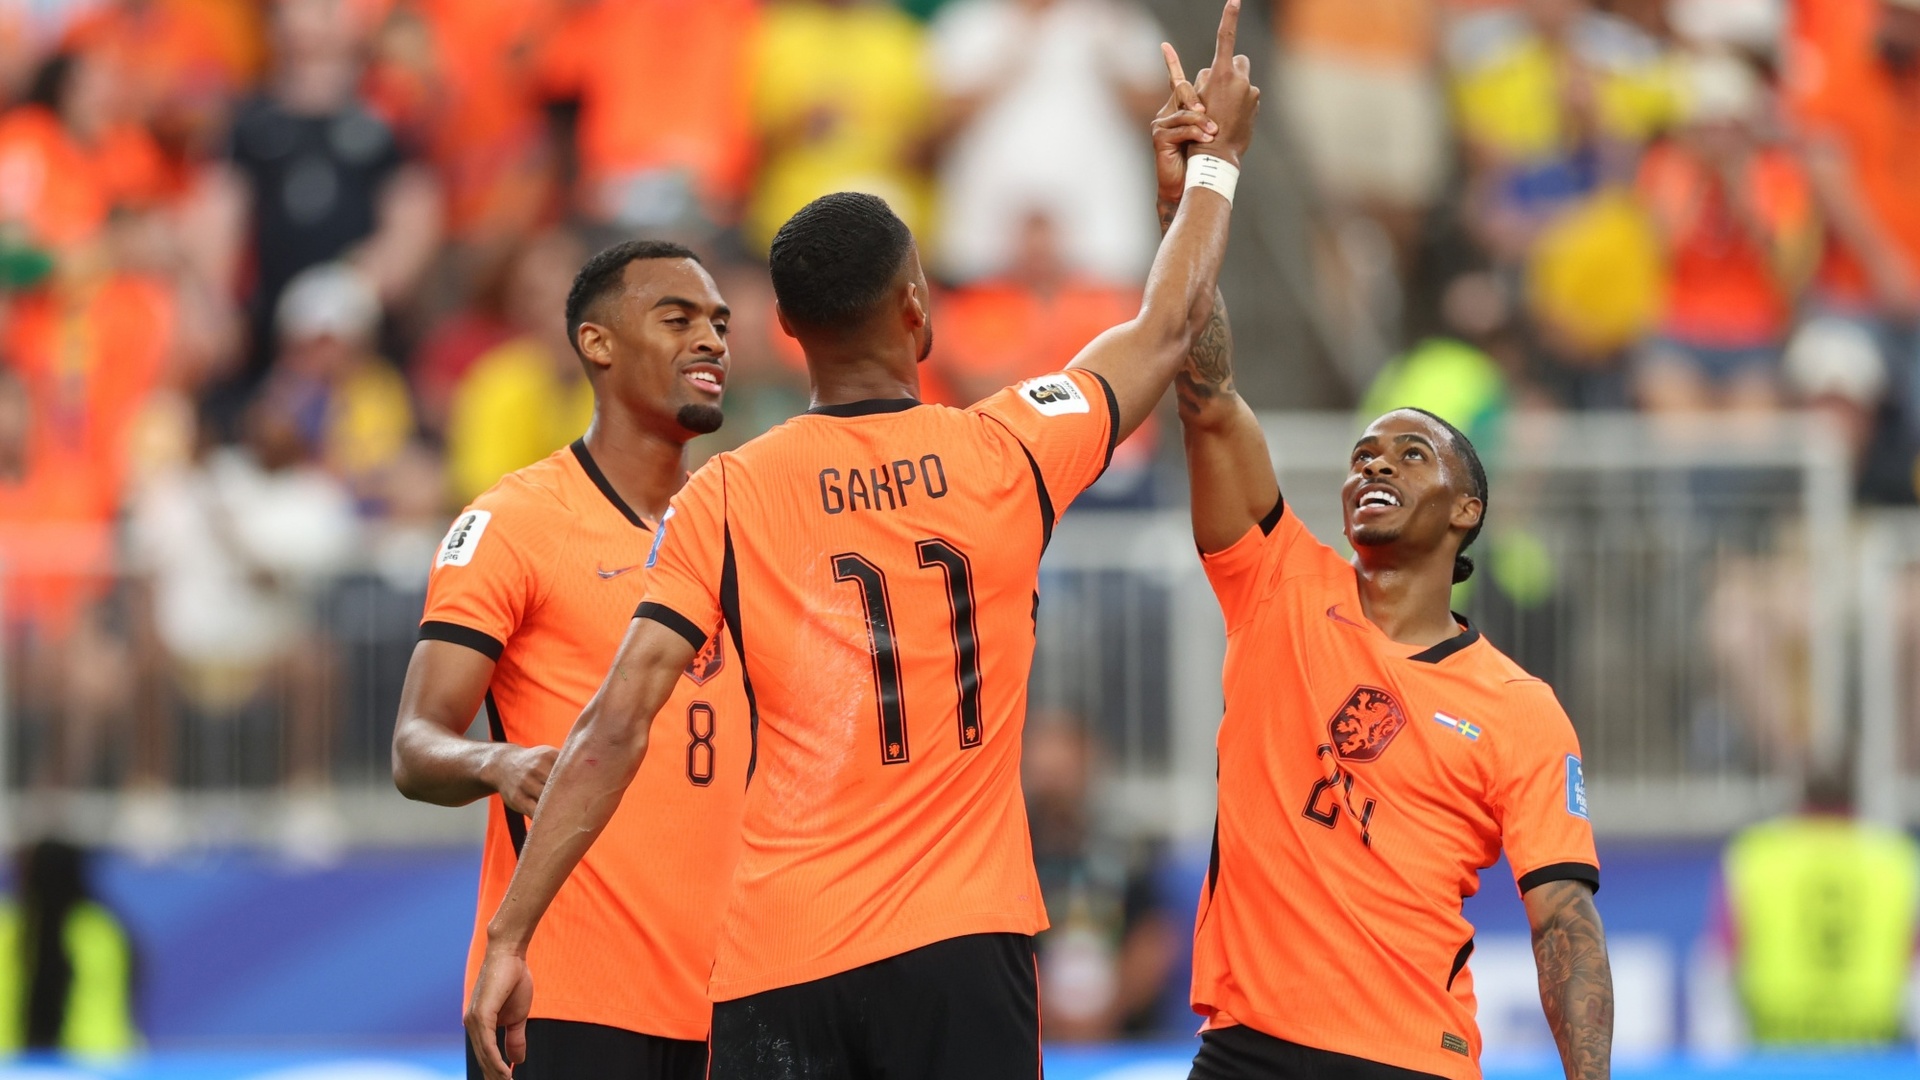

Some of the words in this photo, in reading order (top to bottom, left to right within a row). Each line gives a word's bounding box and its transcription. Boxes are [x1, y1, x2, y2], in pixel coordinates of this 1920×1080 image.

[819, 454, 948, 514] GAKPO
[830, 538, 983, 765] 11
[686, 700, 716, 788] 8
[1302, 743, 1377, 850] 24
